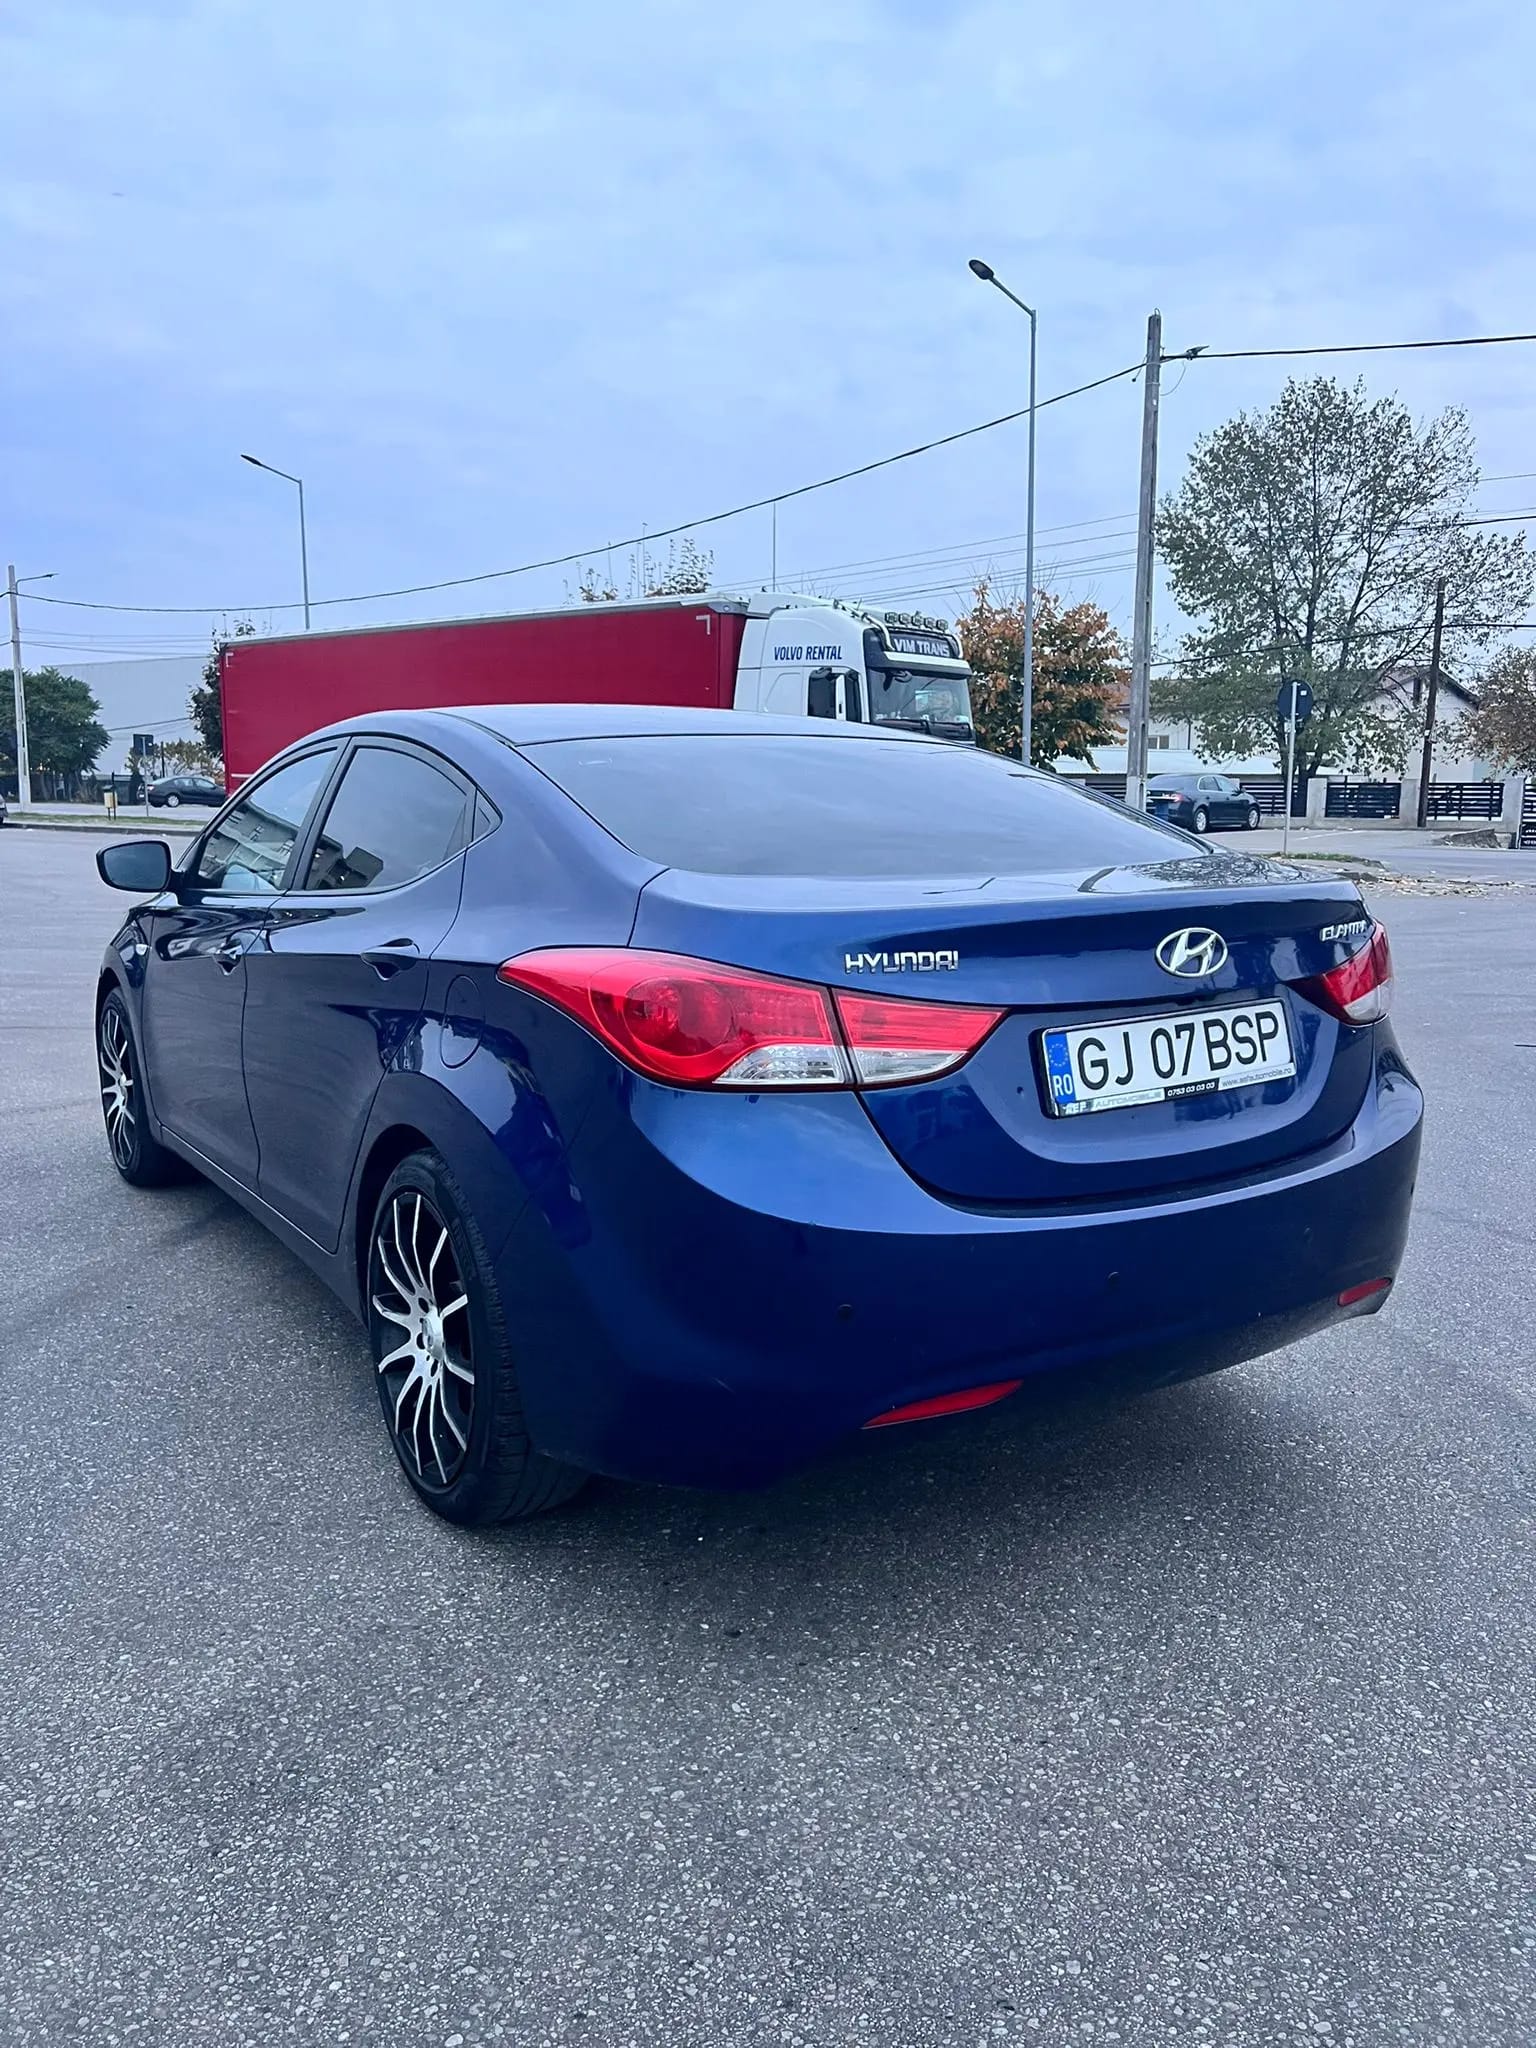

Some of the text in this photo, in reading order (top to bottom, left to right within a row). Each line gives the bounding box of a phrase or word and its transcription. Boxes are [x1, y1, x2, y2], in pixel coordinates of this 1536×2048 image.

[774, 645, 843, 660] VOLVO RENTAL
[893, 639, 950, 657] VIM TRANS
[844, 950, 959, 974] HYUNDAI
[1077, 1010, 1280, 1090] GJ 07 BSP
[1054, 1073, 1074, 1097] RO
[1167, 1081, 1215, 1096] 0753 03 03 03
